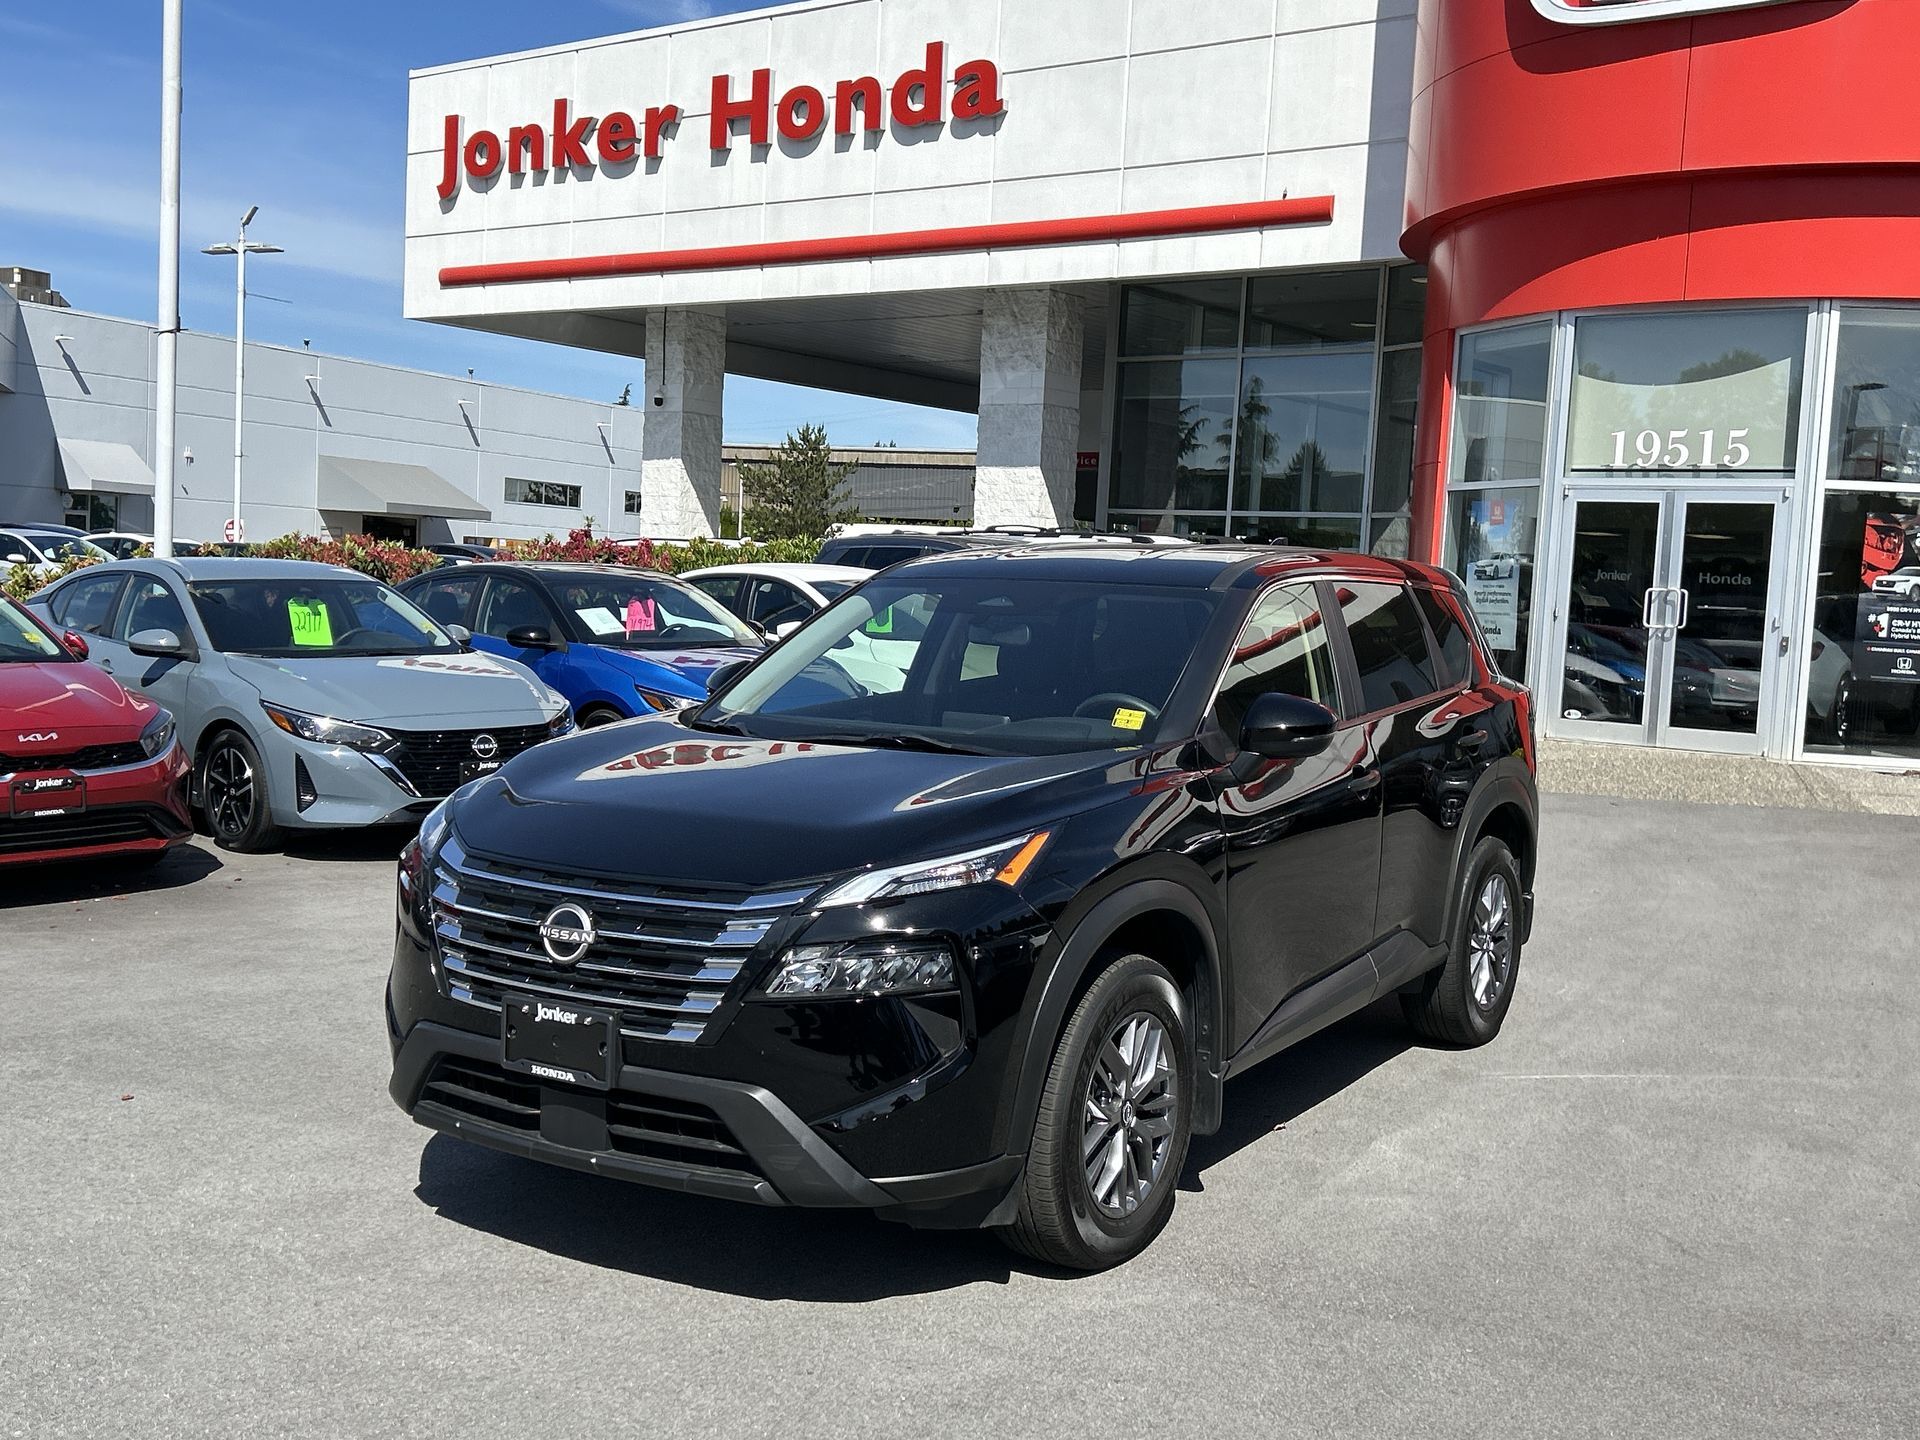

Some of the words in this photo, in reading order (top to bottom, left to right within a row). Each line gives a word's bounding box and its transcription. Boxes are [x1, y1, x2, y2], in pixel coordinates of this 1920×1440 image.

[436, 98, 683, 200] Jonker
[709, 40, 1008, 150] Honda
[1609, 428, 1750, 467] 19515
[1594, 569, 1633, 582] Jonker
[1698, 572, 1752, 586] Honda
[1482, 624, 1501, 635] onda
[1891, 619, 1911, 627] CR-V
[18, 732, 58, 742] KIA
[33, 778, 64, 791] Jonker
[34, 808, 65, 816] HONDA
[539, 925, 594, 944] NISSAN
[535, 1003, 577, 1025] Jonker
[531, 1064, 576, 1082] HONDA
